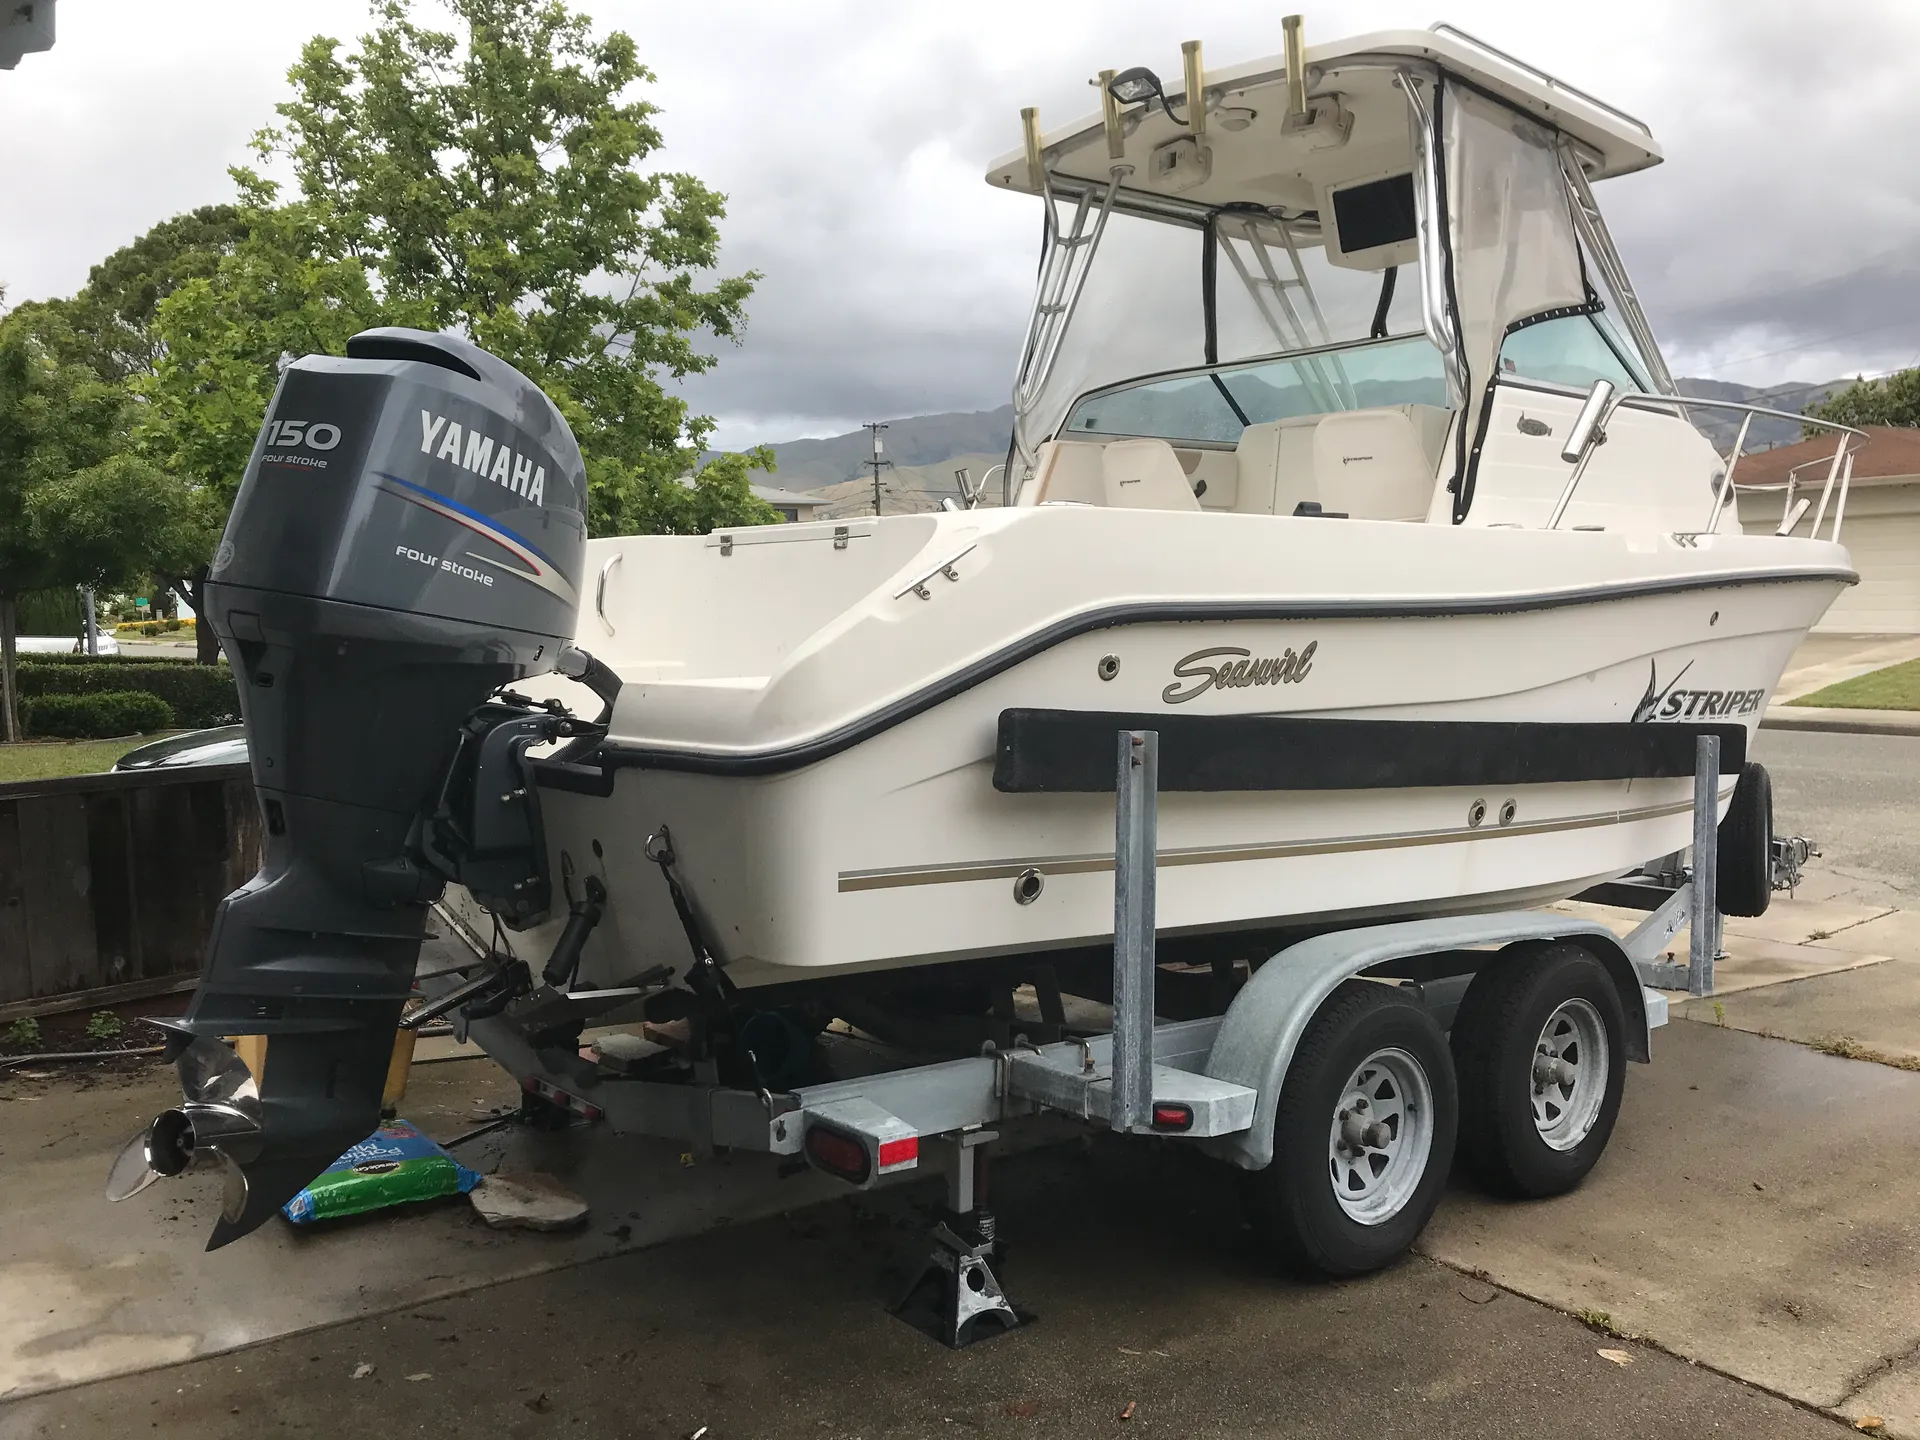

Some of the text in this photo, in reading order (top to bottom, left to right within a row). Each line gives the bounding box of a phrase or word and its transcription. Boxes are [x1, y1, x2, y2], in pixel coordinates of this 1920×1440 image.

[267, 420, 342, 451] 150
[420, 409, 546, 508] YAMAHA
[1162, 640, 1318, 704] Seaswirl
[1660, 688, 1765, 718] STRIPER
[340, 1147, 402, 1160] Pottin
[349, 1143, 379, 1151] Mi
